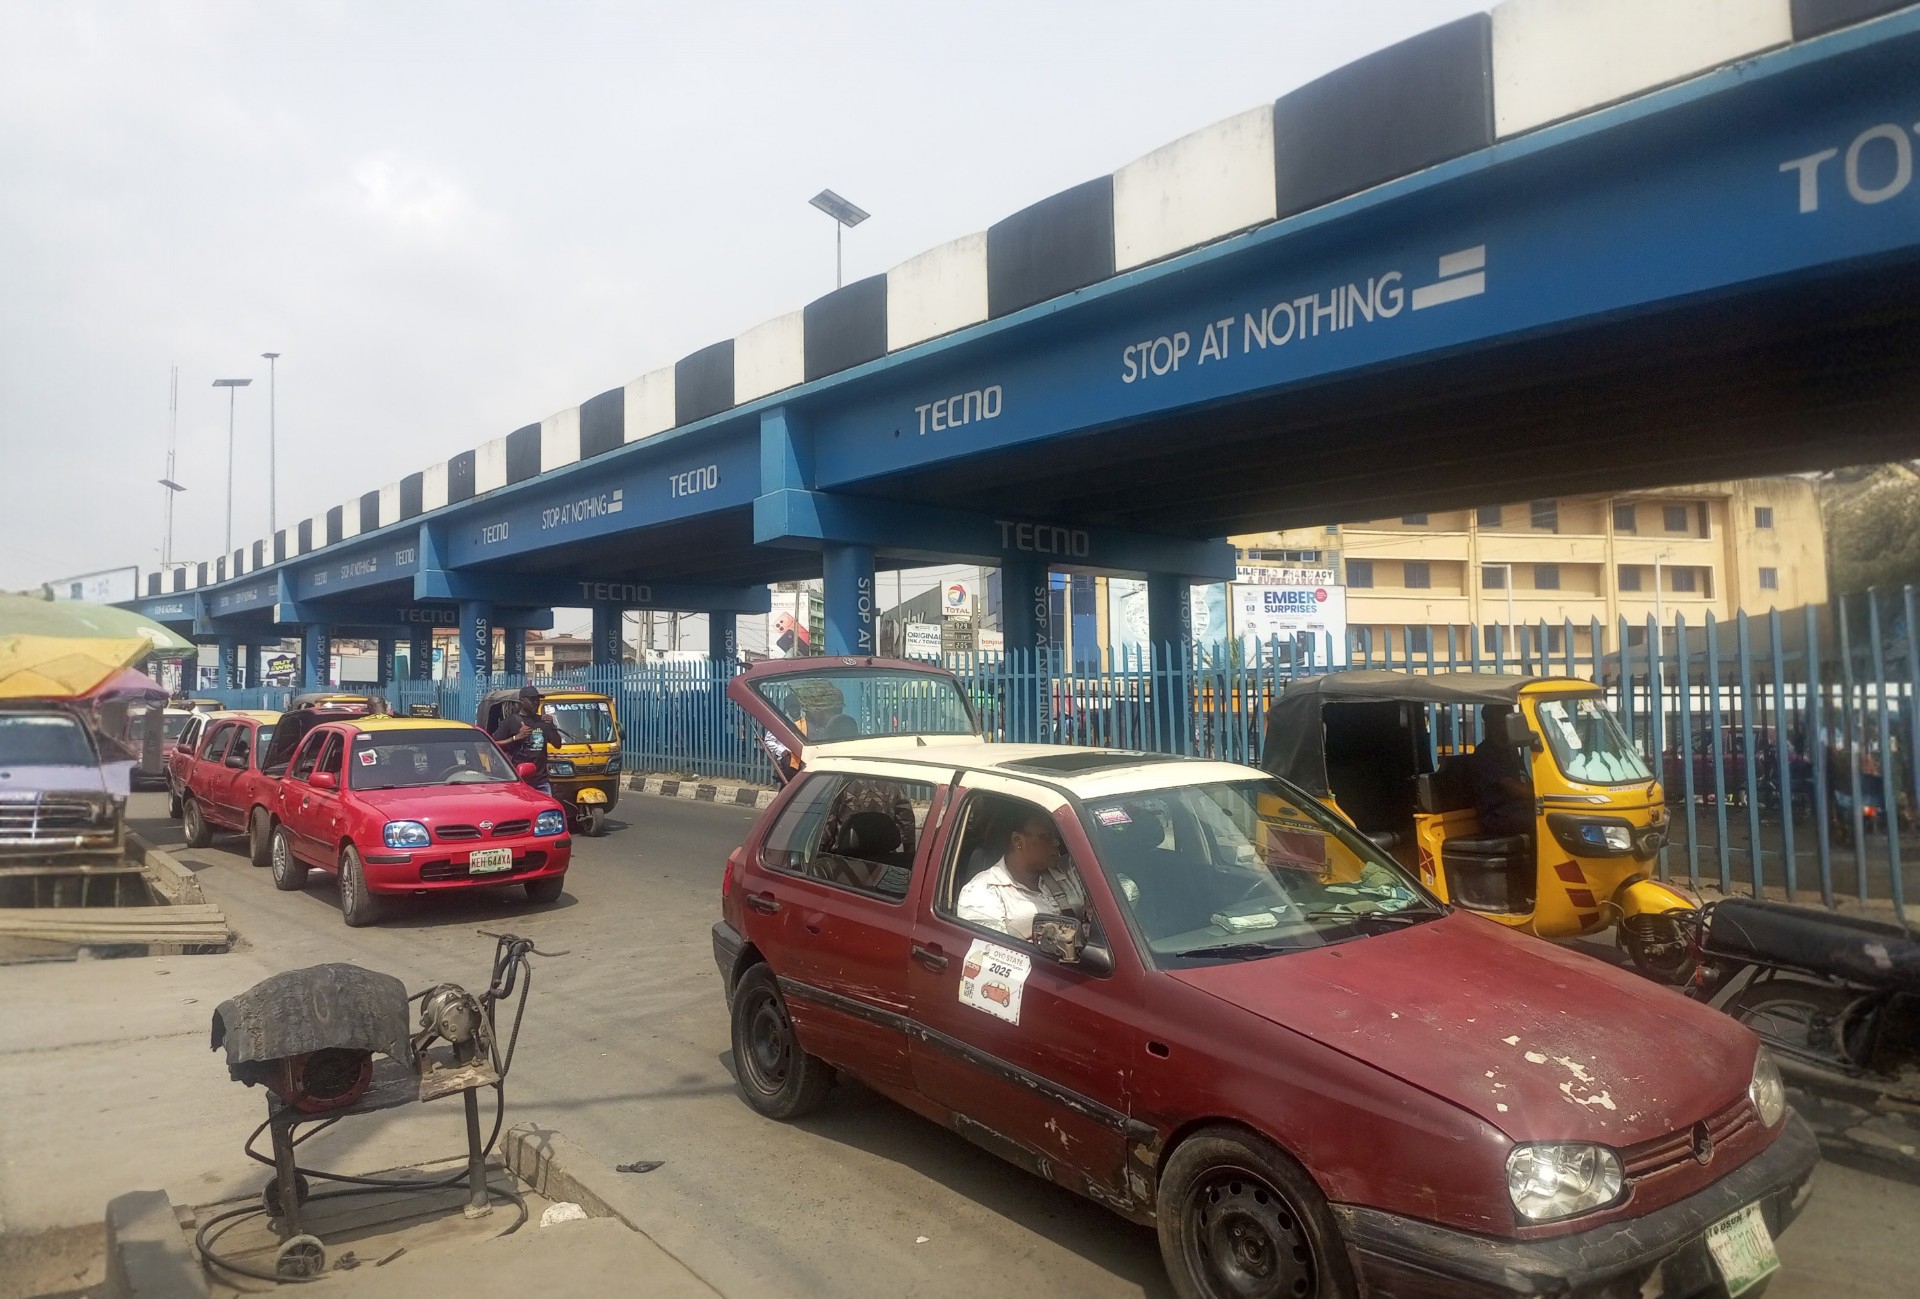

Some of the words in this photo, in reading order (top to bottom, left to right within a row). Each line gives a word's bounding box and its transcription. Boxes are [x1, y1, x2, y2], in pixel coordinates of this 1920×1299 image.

[1779, 122, 1920, 214] TO
[1121, 331, 1190, 384] STOP
[1198, 317, 1234, 365] AT
[1243, 271, 1404, 353] NOTHING
[914, 384, 1002, 436] TECNO
[669, 464, 718, 499] TECNO
[542, 507, 559, 529] STOP
[561, 504, 570, 525] AT
[571, 494, 607, 522] NOTHING
[482, 521, 509, 545] TECNO
[994, 519, 1089, 557] TECNO
[395, 548, 415, 566] TECNO
[577, 581, 651, 602] TECNO
[858, 577, 870, 623] STOP
[1263, 591, 1315, 604] EMBER
[397, 608, 456, 623] TECNO
[945, 606, 970, 614] TOTAL
[1034, 586, 1047, 628] STOP
[1180, 590, 1190, 629] STOP
[1264, 605, 1317, 614] SURPRISES
[475, 618, 486, 646] STOP
[609, 629, 617, 655] STOP
[725, 629, 734, 654] STOP
[858, 628, 871, 652] AT
[317, 635, 325, 655] STOP
[420, 640, 428, 659] STOP
[475, 648, 487, 663] AT
[420, 660, 428, 670] AT
[515, 663, 522, 672] AT
[989, 962, 1012, 978] 2025
